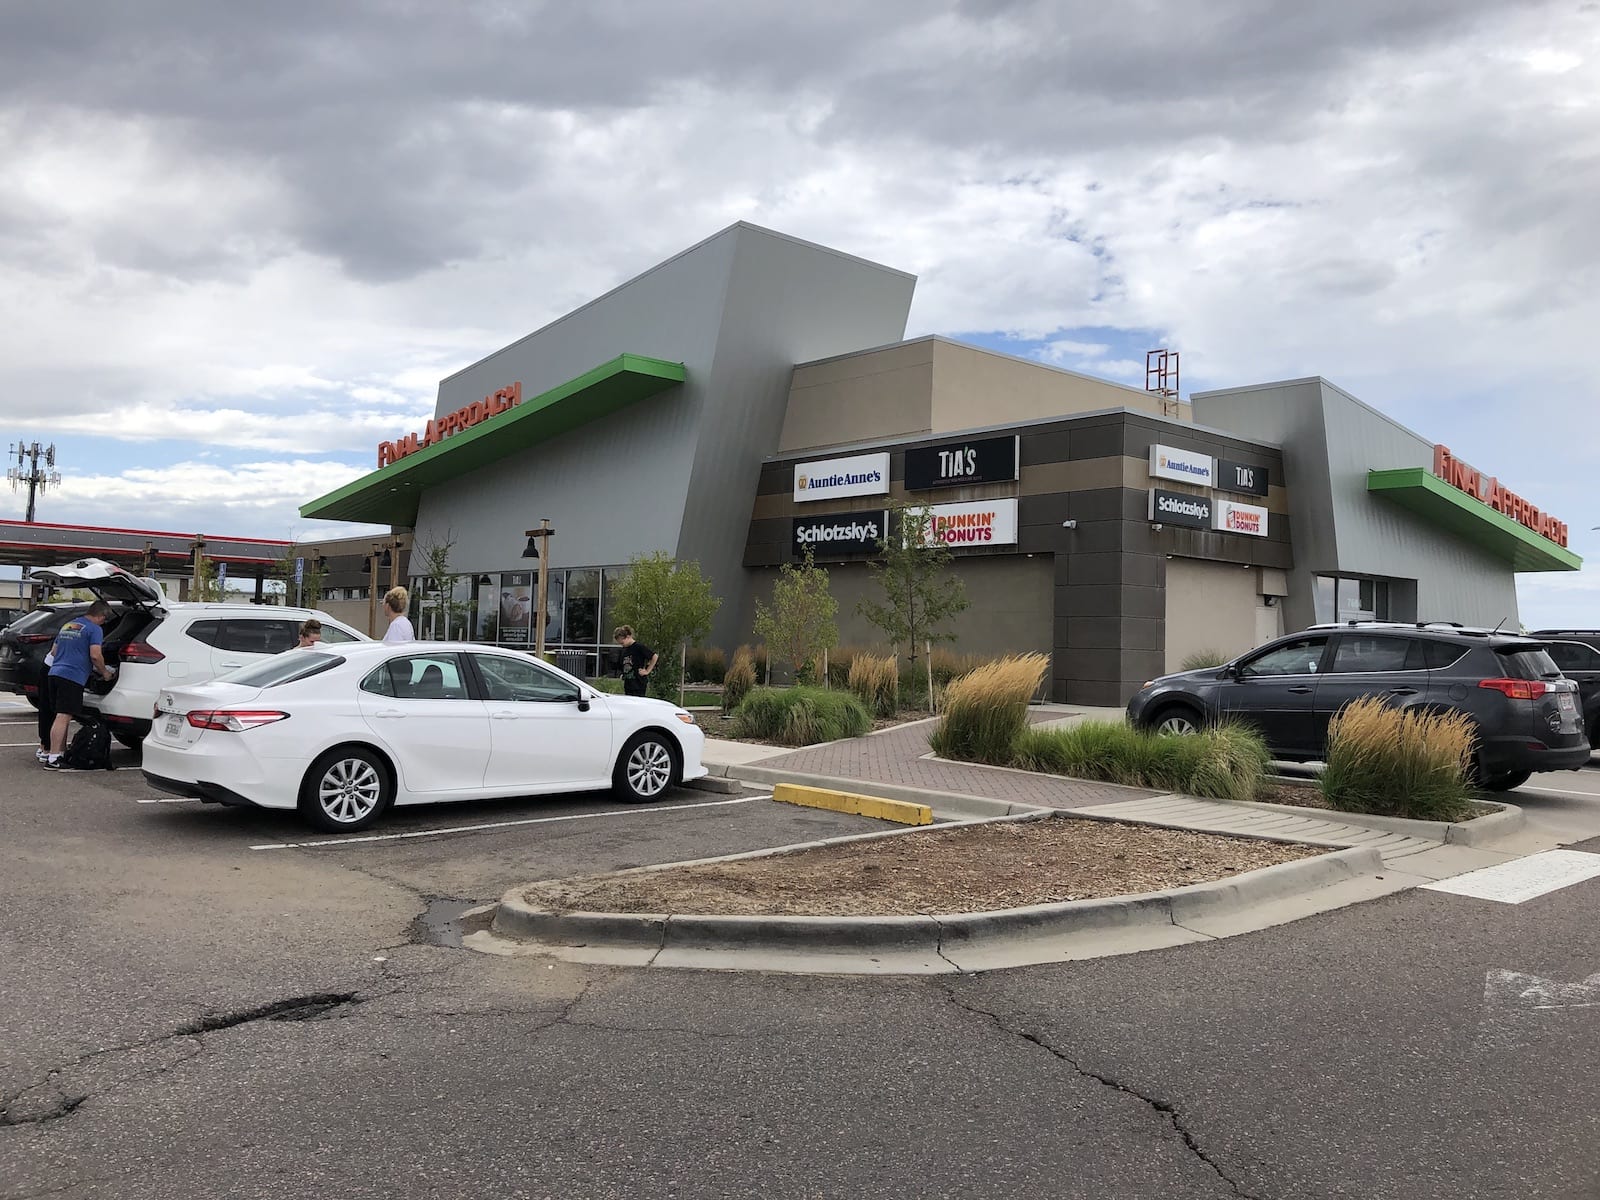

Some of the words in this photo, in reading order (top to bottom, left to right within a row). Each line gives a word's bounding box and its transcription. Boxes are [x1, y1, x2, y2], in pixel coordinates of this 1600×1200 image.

[378, 432, 420, 468] FINAL
[423, 382, 521, 447] APPROACH
[938, 446, 977, 478] TIA'S
[1434, 444, 1487, 503] FINAL
[1488, 476, 1568, 548] APPROACH
[1158, 496, 1209, 519] Schlotzsky's
[938, 512, 995, 528] DUNKIN'
[1236, 521, 1260, 532] DONUTS
[796, 521, 878, 543] Schlotzsky's
[938, 527, 992, 543] DONUTS
